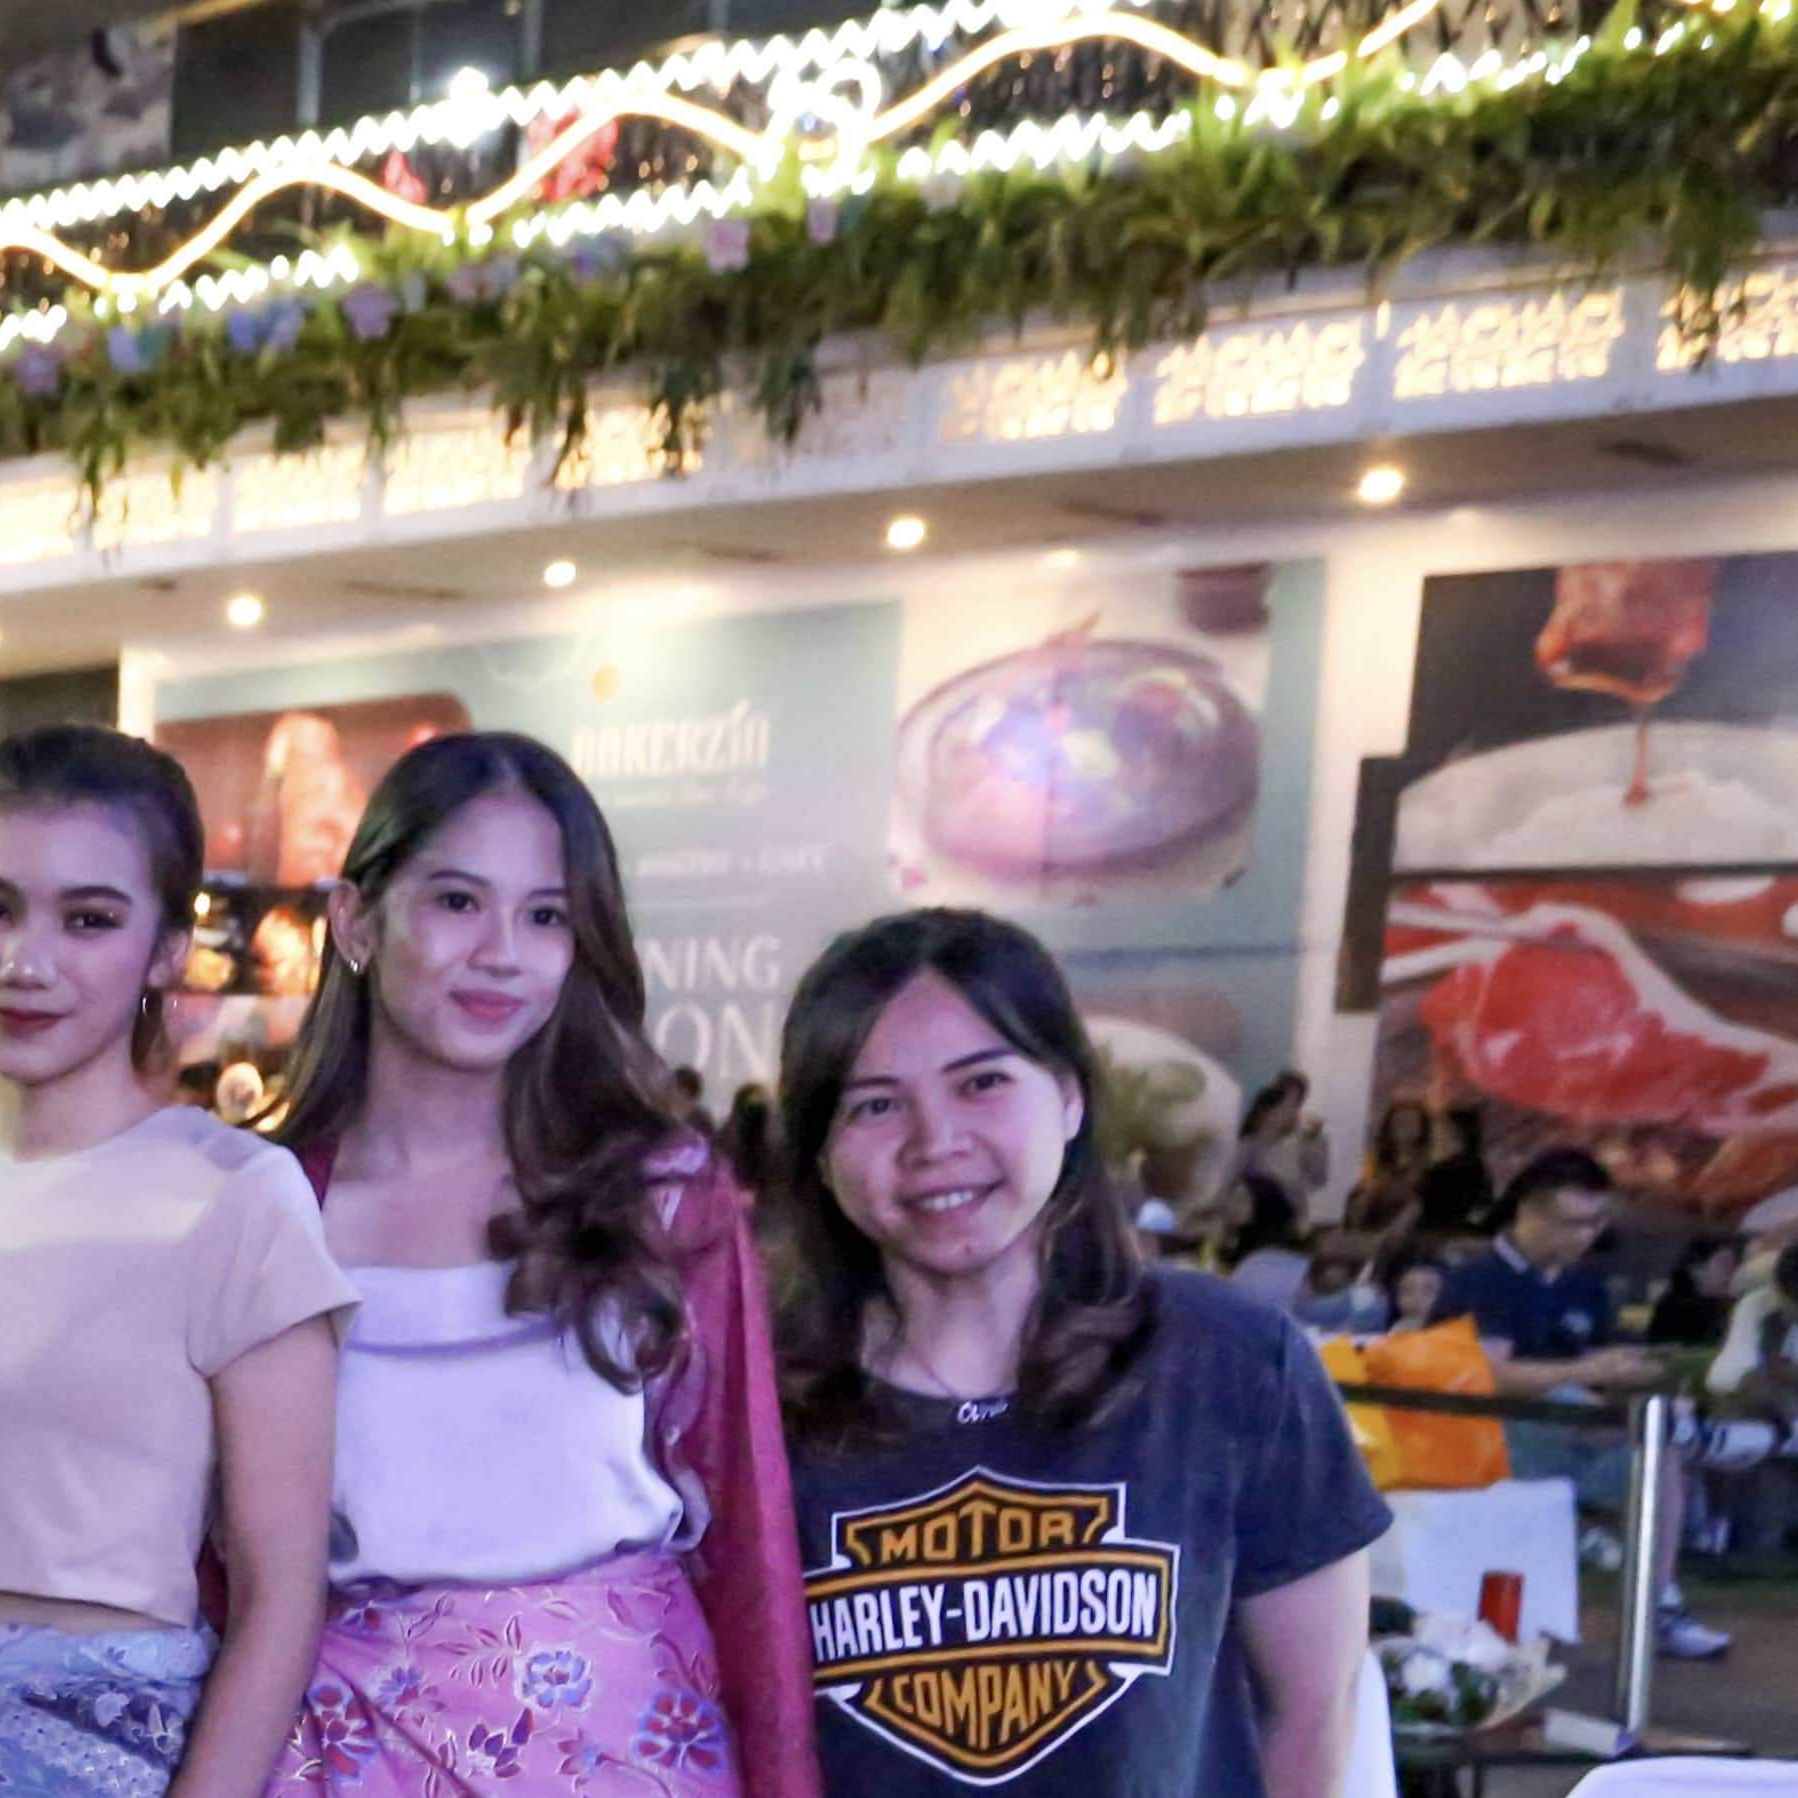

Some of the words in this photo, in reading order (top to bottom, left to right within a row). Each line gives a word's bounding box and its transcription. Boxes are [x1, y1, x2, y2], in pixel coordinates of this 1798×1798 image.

[879, 1499, 1076, 1564] MOTOR
[809, 1568, 1158, 1662] HARLEY-DAVIDSON
[894, 1658, 1077, 1750] COMPANY
